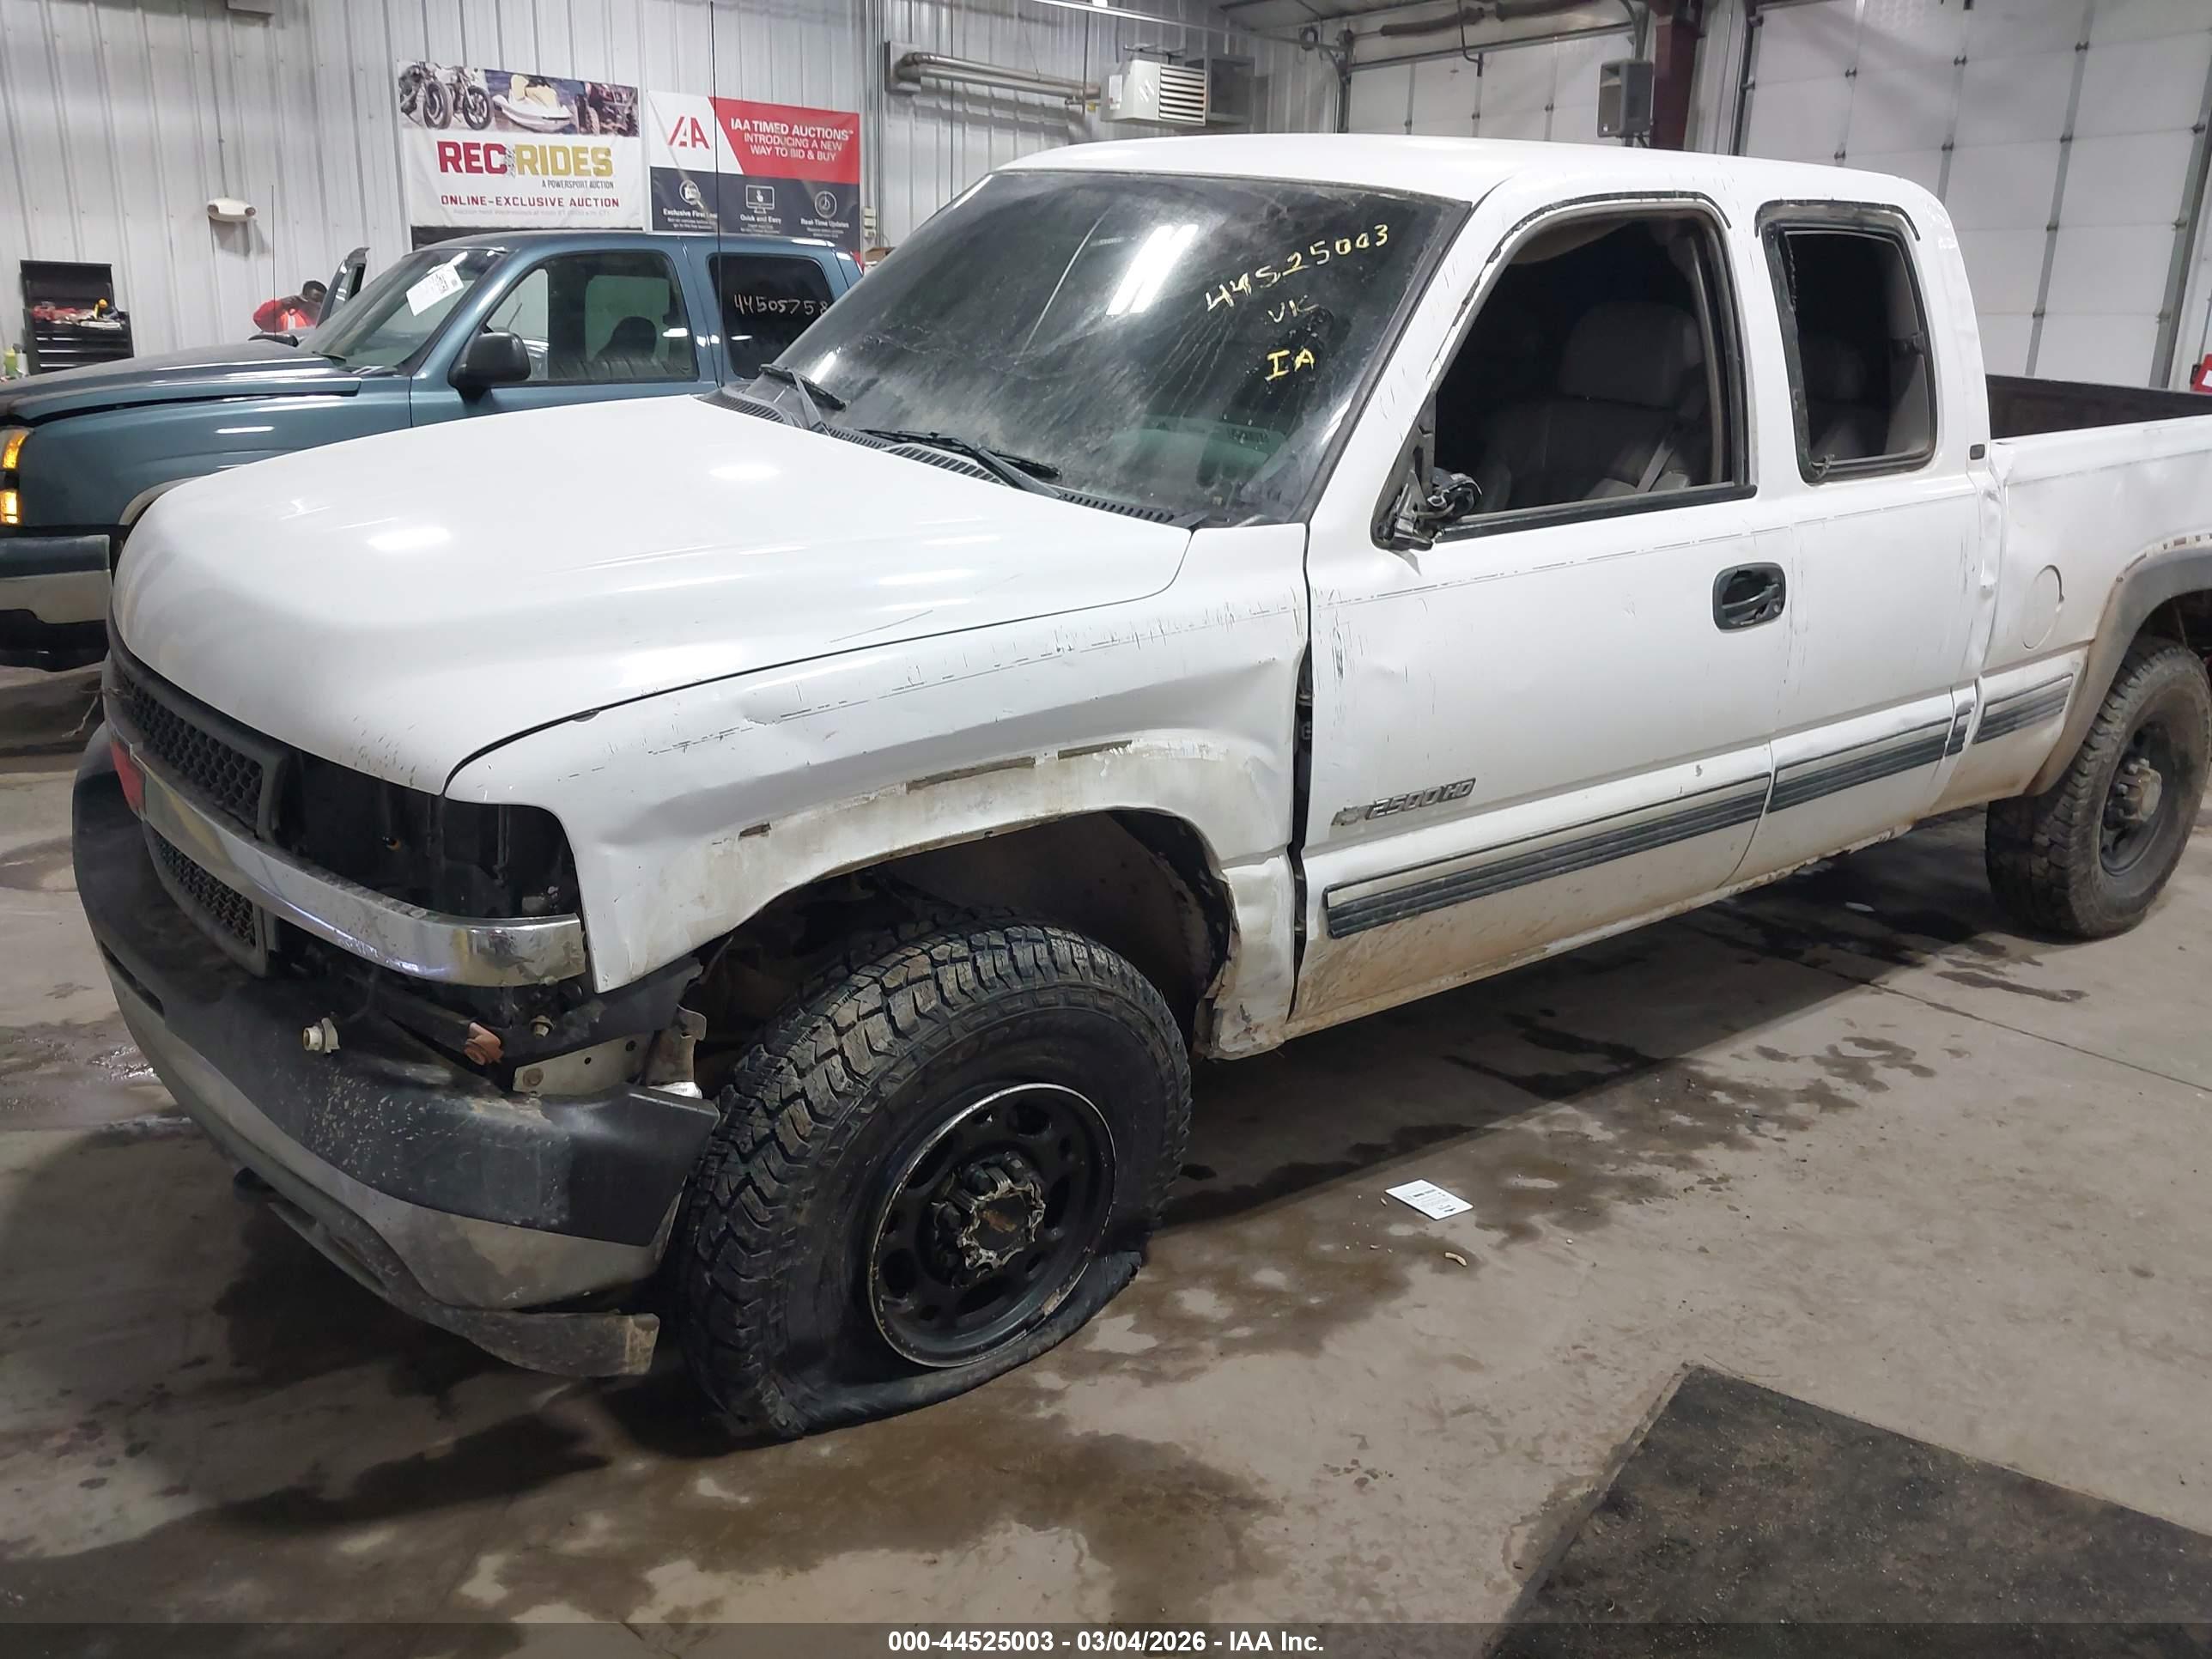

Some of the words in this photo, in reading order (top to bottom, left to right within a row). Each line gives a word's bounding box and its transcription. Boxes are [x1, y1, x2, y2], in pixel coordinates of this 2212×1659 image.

[731, 117, 751, 131] IAA
[751, 119, 789, 135] TIMED
[744, 131, 809, 149] INTRODUCING
[811, 138, 818, 149] A
[820, 140, 842, 152] NEW
[436, 141, 508, 174] REC
[514, 143, 613, 177] RIDES
[750, 143, 773, 156] WAY
[775, 146, 788, 158] TO
[790, 148, 805, 160] BID
[807, 149, 815, 161] &
[817, 150, 837, 162] BUY
[547, 179, 588, 190] POWERSPORT
[589, 180, 614, 190] AUCTION
[441, 194, 564, 207] ONLINE-EXCLUSIVE
[569, 197, 619, 208] AUCTION
[662, 208, 691, 217] Exclusive
[739, 214, 756, 222] Quick
[1205, 223, 1389, 313] 44525003
[734, 294, 829, 315] 44505758
[1264, 348, 1315, 381] IA
